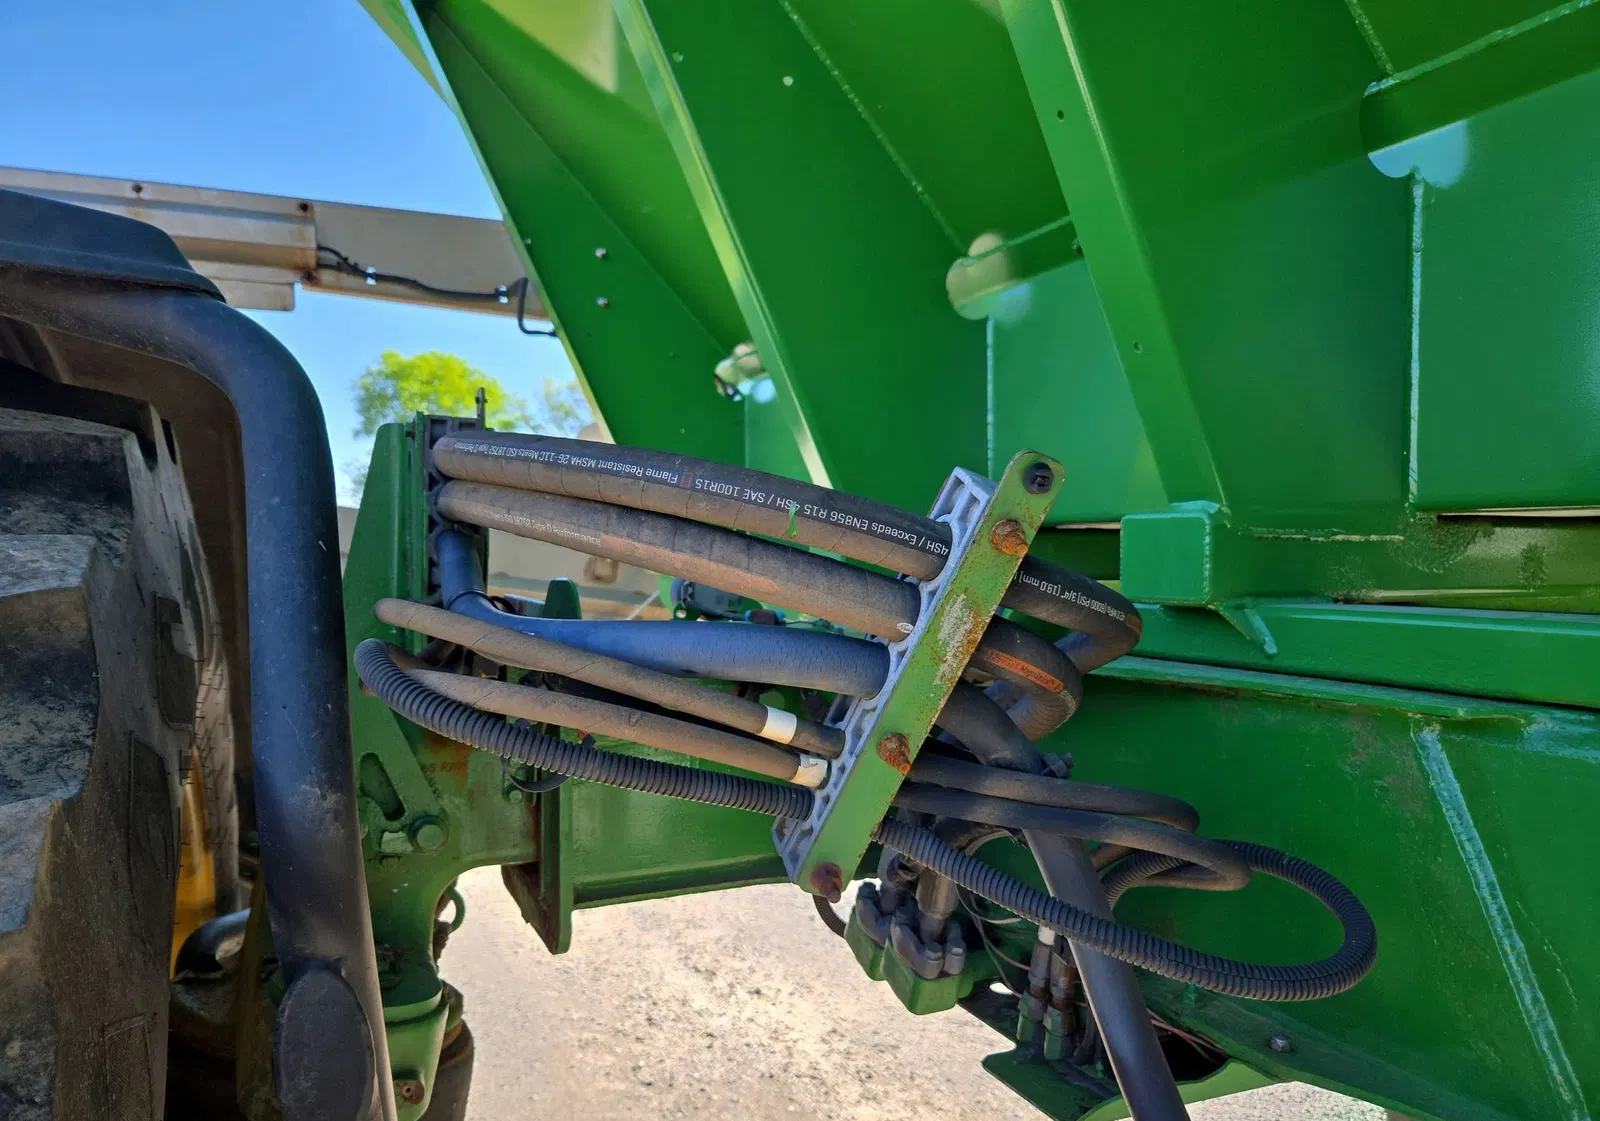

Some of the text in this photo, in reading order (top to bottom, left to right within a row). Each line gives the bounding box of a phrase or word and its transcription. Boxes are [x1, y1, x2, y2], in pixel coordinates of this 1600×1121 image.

[479, 443, 489, 455] Type
[488, 445, 505, 456] 18752
[506, 447, 517, 457] ISO
[518, 448, 538, 460] Meets
[571, 454, 597, 468] MSHA
[599, 459, 644, 477] Resistant
[645, 469, 679, 484] Flame
[695, 478, 740, 497] 100R15
[742, 488, 766, 503] SAE
[767, 493, 775, 504] /
[775, 498, 800, 512] 4SH
[803, 503, 828, 519] R15
[829, 510, 869, 531] EN856
[553, 525, 601, 546] Performance
[871, 522, 917, 545] Exceeds
[918, 536, 926, 547] /
[926, 539, 949, 556] 4SH
